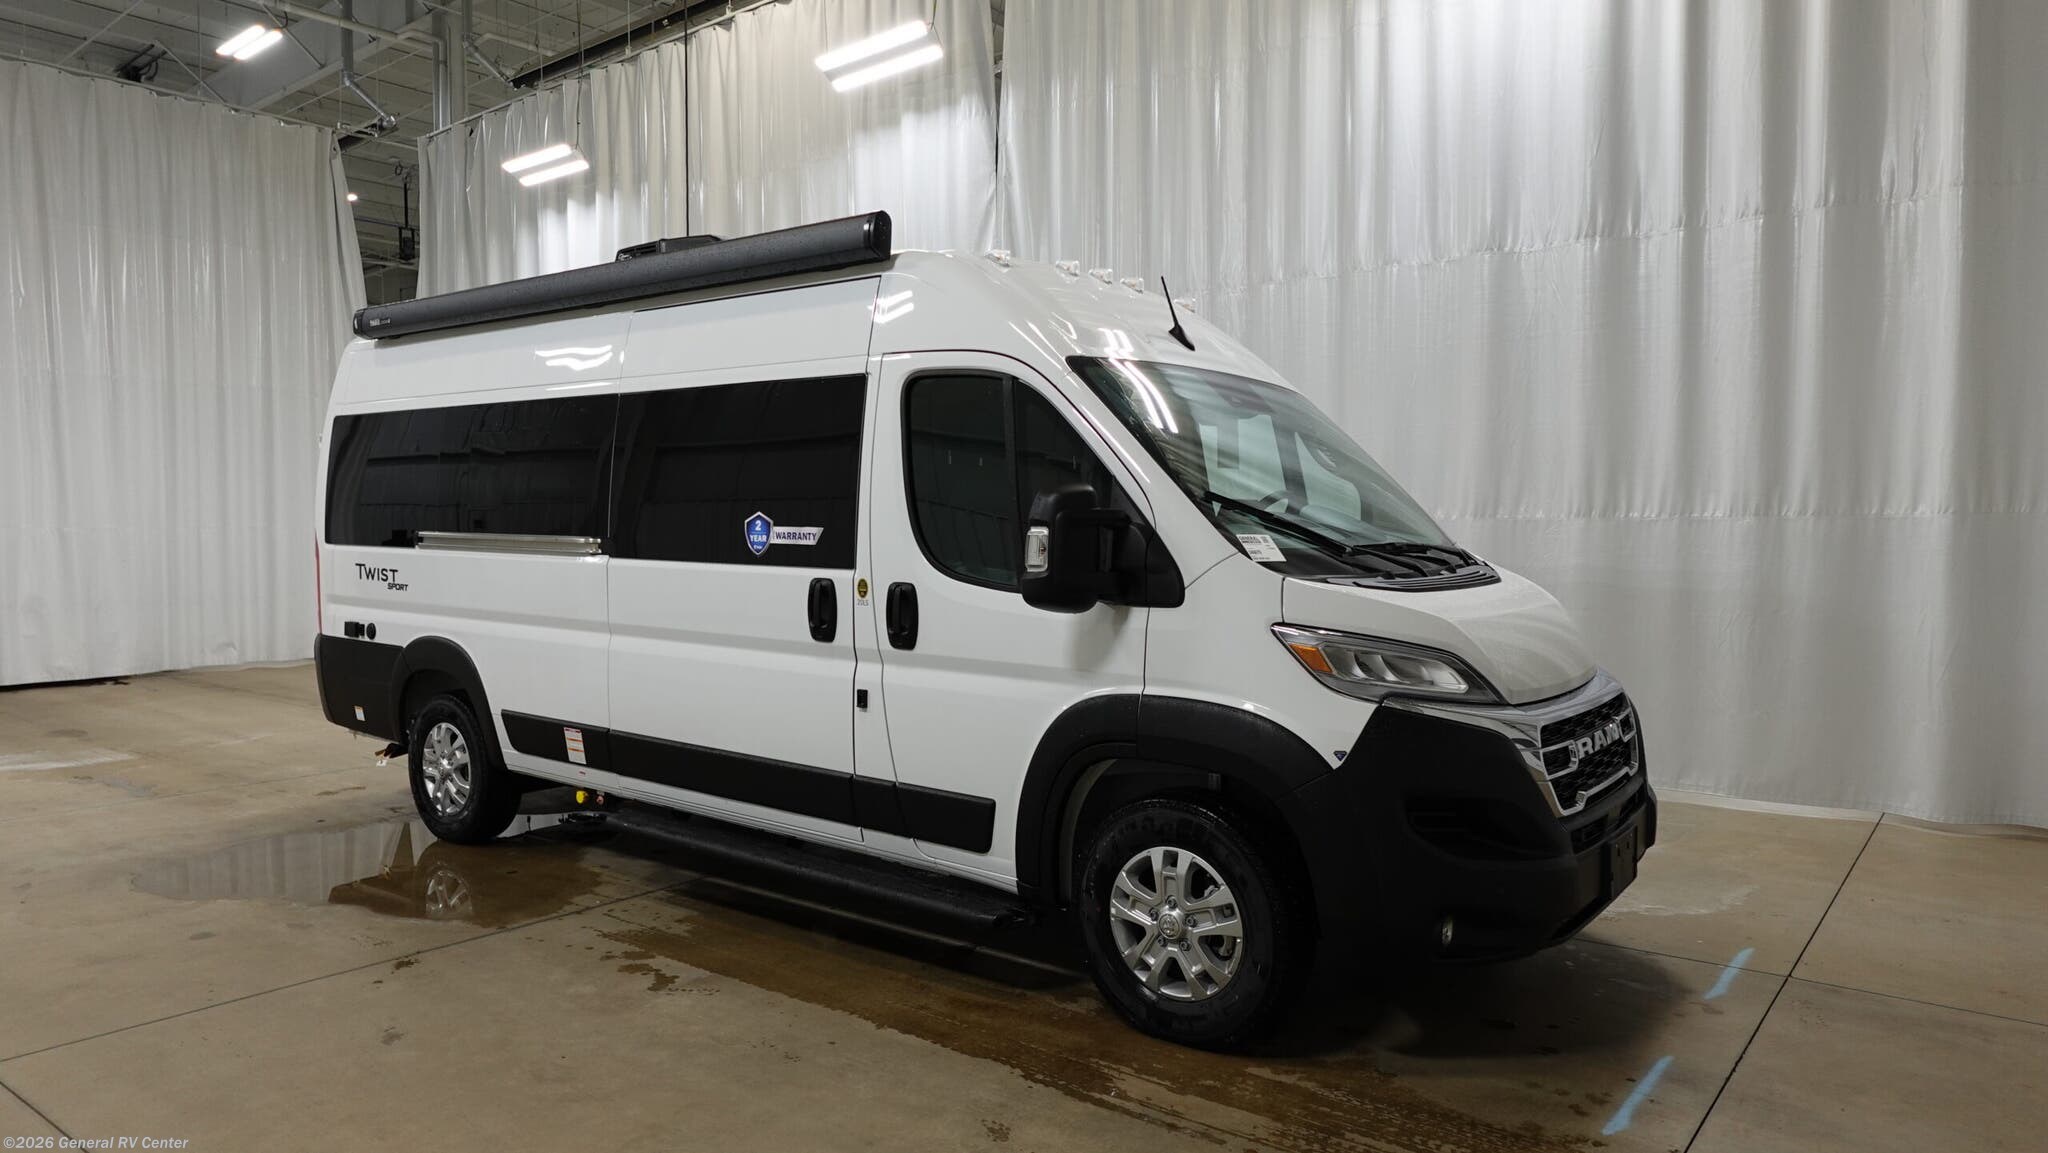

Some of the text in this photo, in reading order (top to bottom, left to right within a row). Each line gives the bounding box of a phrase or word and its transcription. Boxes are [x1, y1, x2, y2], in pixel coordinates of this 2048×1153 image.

[755, 520, 761, 531] 2
[749, 534, 767, 542] YEAR
[775, 531, 817, 541] WARRANTY
[355, 563, 398, 582] TWIST
[387, 582, 408, 591] SPORT
[1576, 722, 1620, 760] RAM
